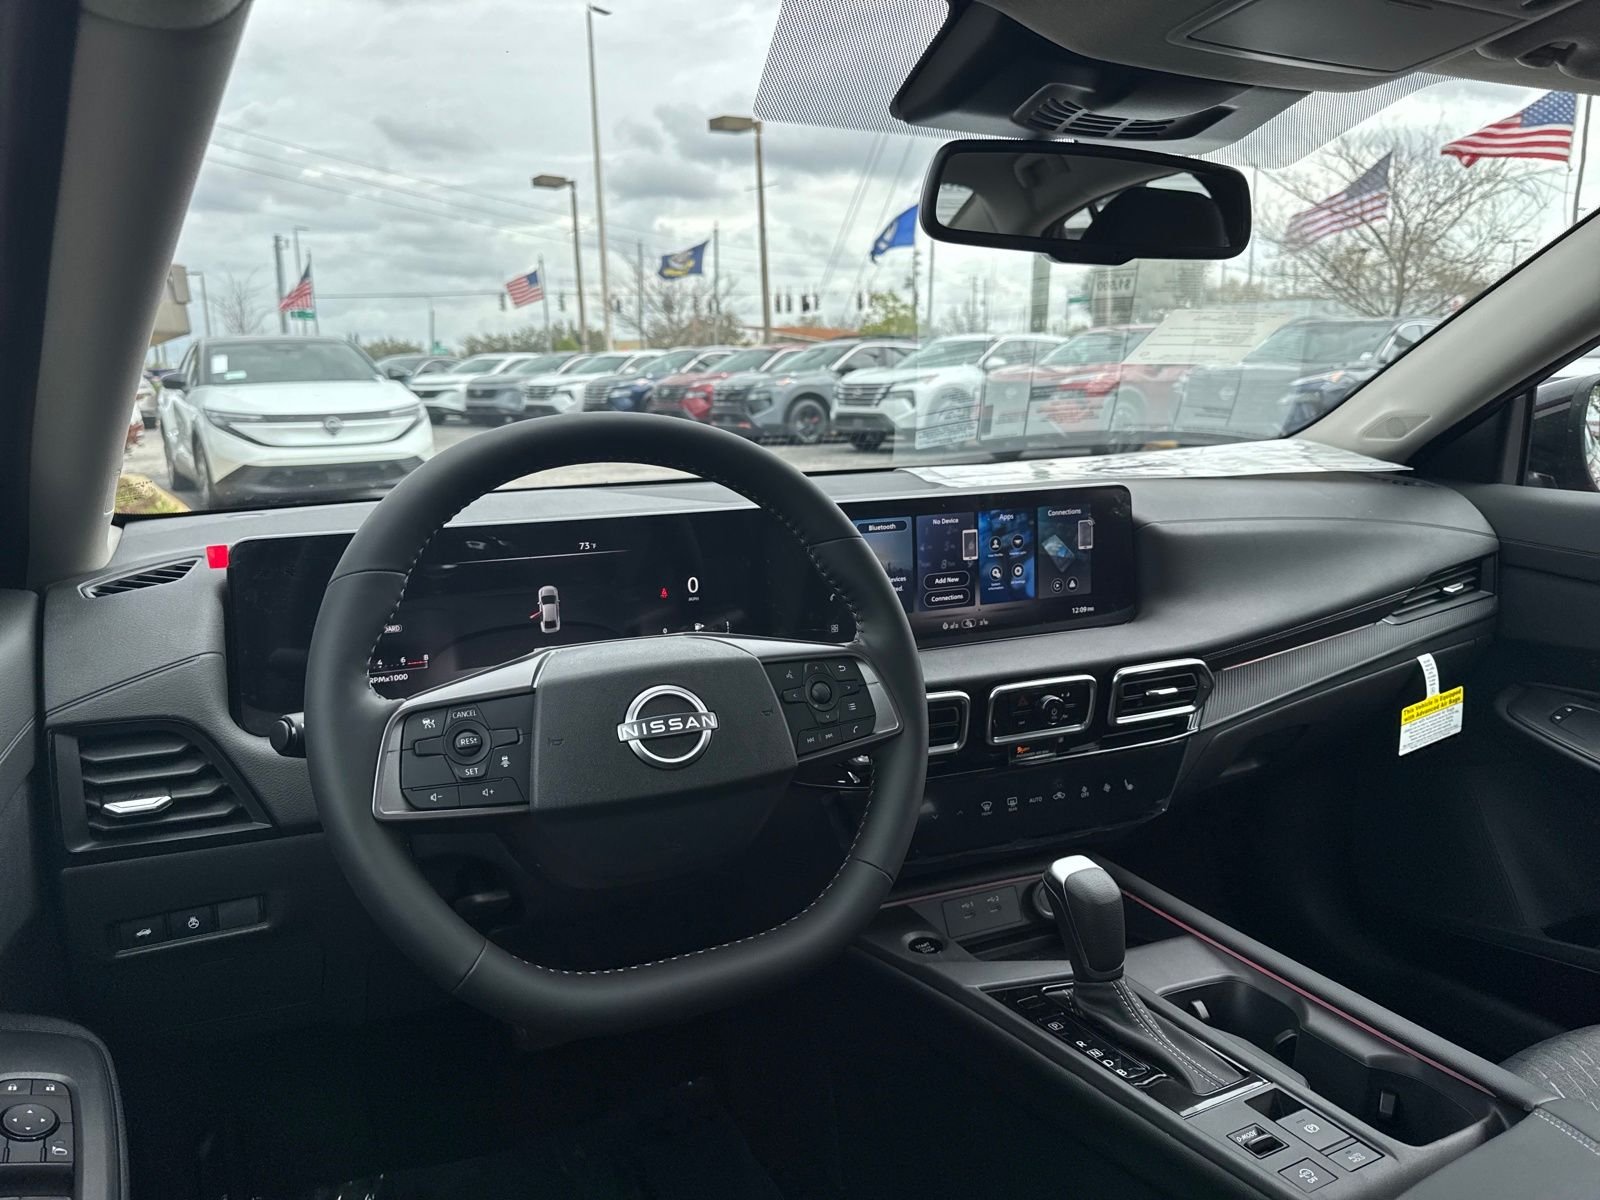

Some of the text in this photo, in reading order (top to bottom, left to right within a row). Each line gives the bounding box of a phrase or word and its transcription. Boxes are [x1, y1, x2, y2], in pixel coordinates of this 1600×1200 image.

[1047, 508, 1082, 516] Connections
[999, 513, 1014, 521] Apps
[868, 523, 897, 531] Bluetooth
[578, 542, 590, 550] 73
[687, 576, 699, 593] 0
[931, 593, 964, 603] Connections
[452, 709, 477, 719] CANCEL
[621, 714, 717, 739] NISSAN
[464, 767, 479, 776] SET
[1075, 1040, 1087, 1048] R
[1102, 1059, 1115, 1067] D
[1115, 1068, 1128, 1077] B
[1236, 1129, 1257, 1143] D-MODE
